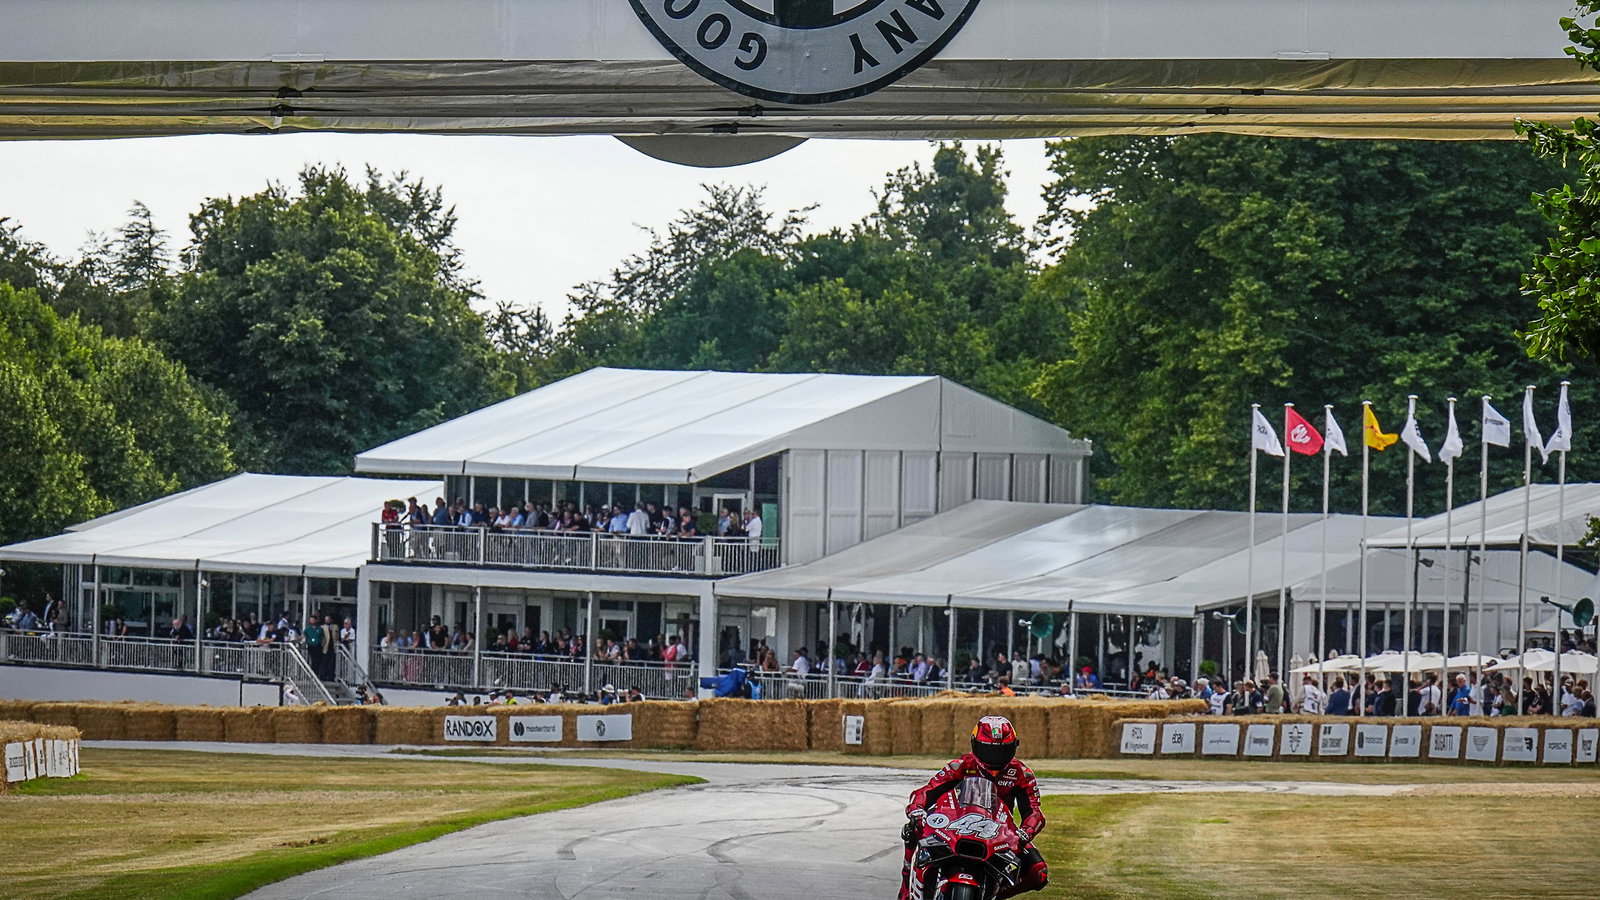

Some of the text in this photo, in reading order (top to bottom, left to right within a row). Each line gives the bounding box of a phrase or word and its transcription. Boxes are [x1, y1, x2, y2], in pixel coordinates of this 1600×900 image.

[445, 720, 494, 737] RANDOX
[931, 816, 944, 825] 49
[945, 812, 1001, 840] 44
